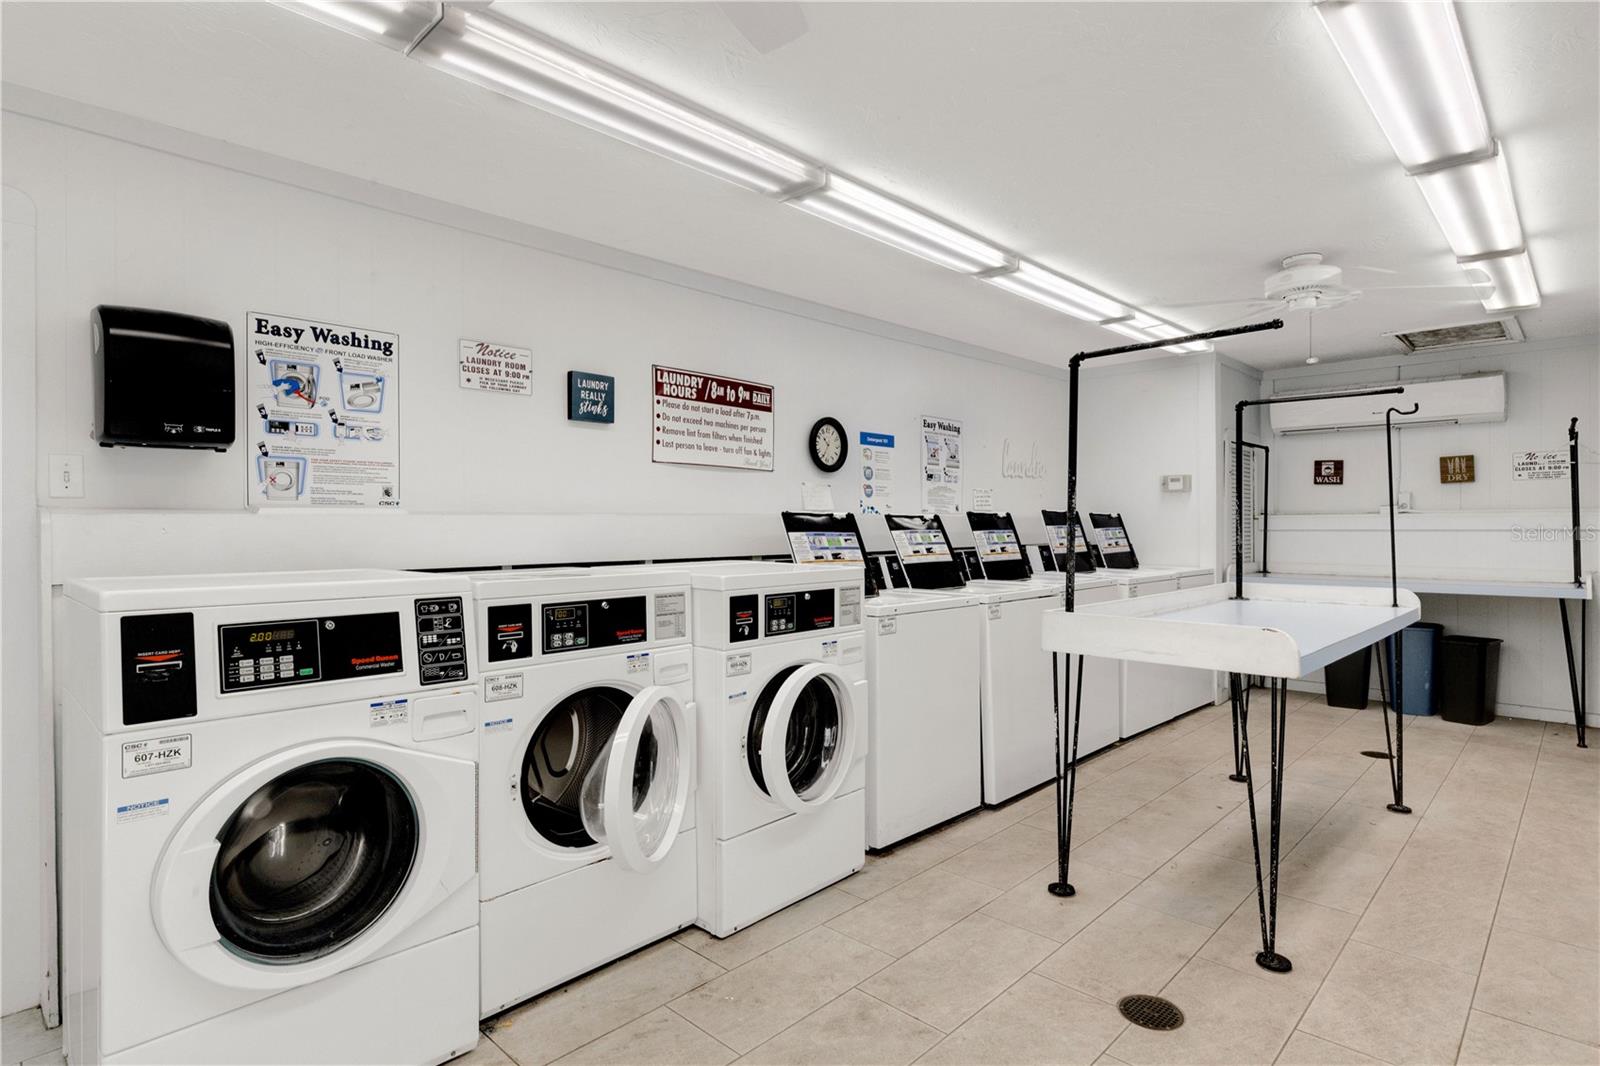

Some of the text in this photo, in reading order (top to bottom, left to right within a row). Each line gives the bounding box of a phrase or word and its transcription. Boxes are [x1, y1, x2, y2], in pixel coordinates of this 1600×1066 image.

[255, 318, 305, 344] Easy
[310, 326, 394, 356] Washing
[254, 340, 314, 352] HIGH-EFFICIENCY
[325, 349, 346, 357] FRONT
[367, 354, 393, 363] WASHER
[476, 342, 517, 360] Notice
[462, 365, 490, 375] CLOSES
[505, 371, 521, 379] 9:00
[466, 356, 526, 371] LAUNDRY ROOM
[578, 378, 609, 391] LAUNDRY
[657, 370, 704, 389] LAUNDRY
[580, 390, 606, 402] REALLY
[663, 384, 697, 400] HOURS
[726, 386, 735, 402] to
[738, 386, 750, 403] 9PM
[752, 394, 770, 404] DAILY
[579, 400, 608, 417] stinks
[662, 399, 681, 410] Please
[682, 402, 689, 410] do
[691, 403, 700, 412] not
[701, 405, 714, 414] start
[720, 407, 732, 416] load
[733, 409, 745, 418] after
[662, 412, 766, 434] Do not exceed two machines per person
[922, 419, 936, 431] Easy
[938, 422, 960, 435] Washing
[662, 426, 685, 436] Remove
[687, 428, 696, 437] lint
[697, 430, 710, 439] from
[712, 432, 727, 441] filters
[743, 436, 763, 445] finished
[662, 440, 674, 448] Last
[676, 442, 695, 450] person
[703, 443, 718, 452] leave
[744, 447, 752, 455] fan
[758, 449, 771, 459] lights
[1448, 473, 1470, 481] DRY
[352, 656, 375, 664] Speed
[134, 748, 181, 762] 607-HZK
